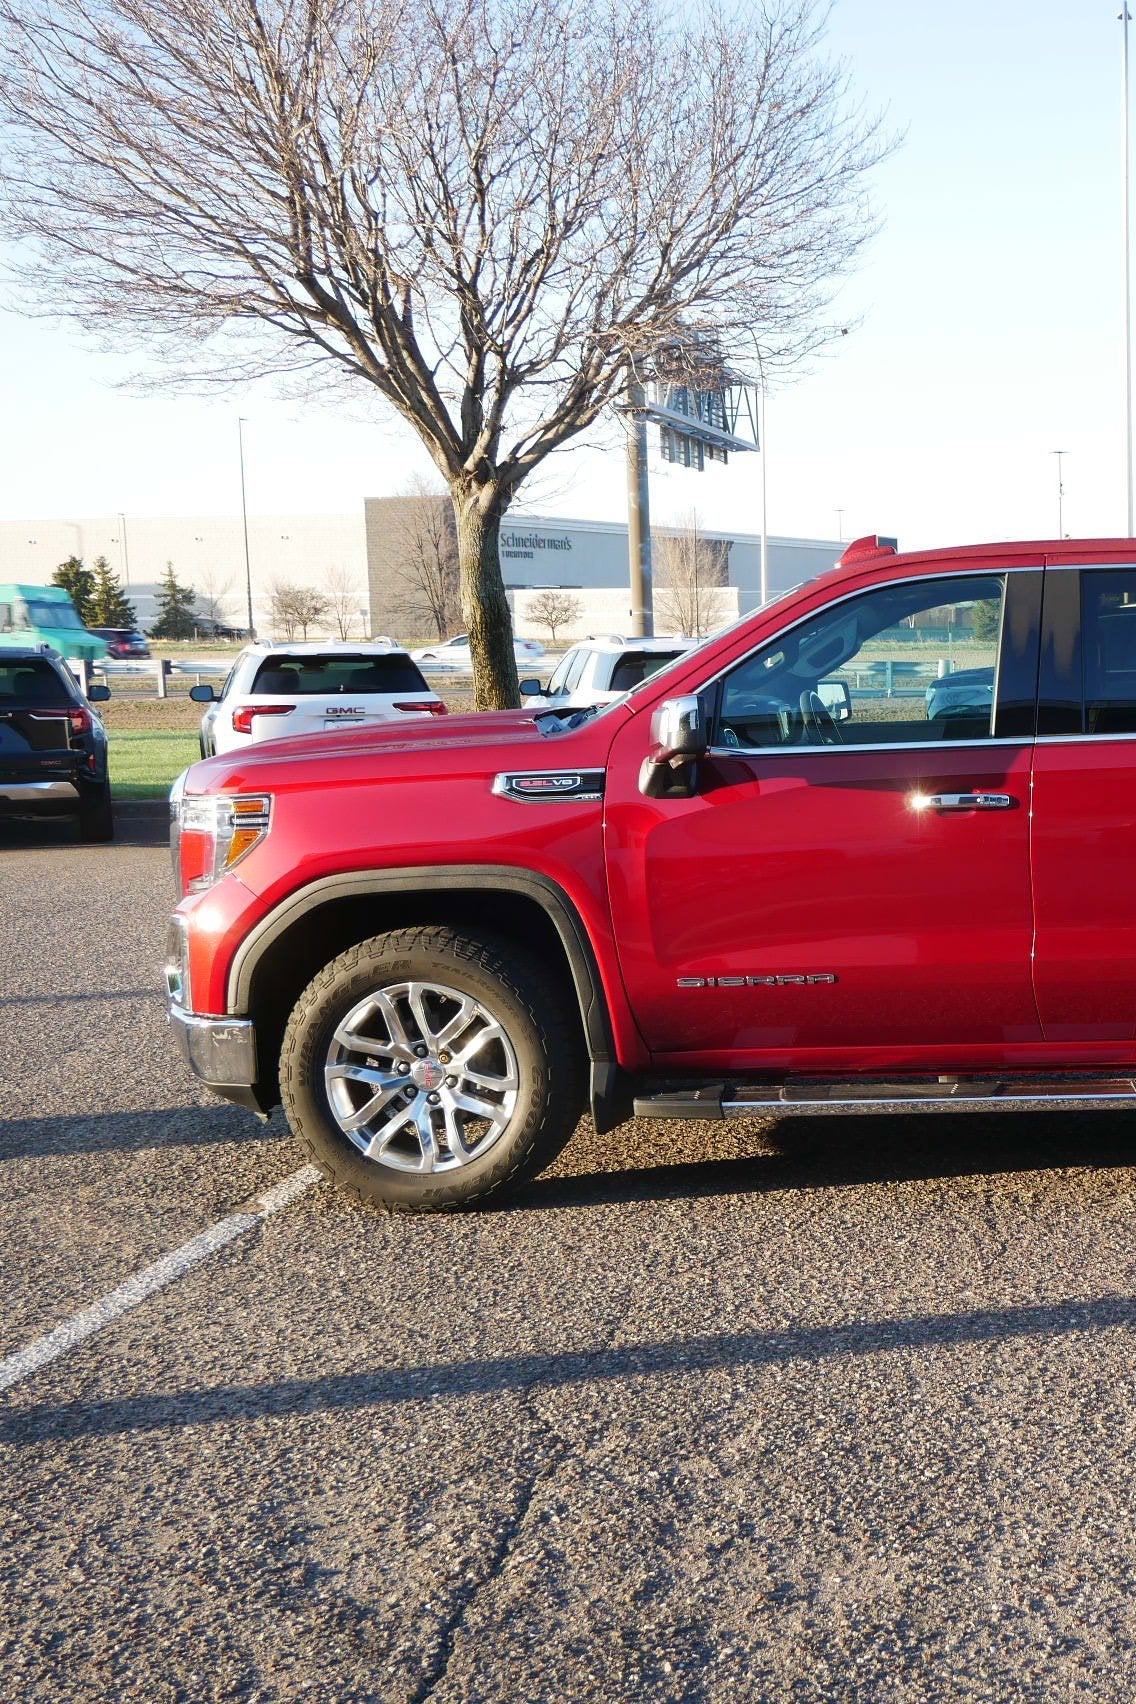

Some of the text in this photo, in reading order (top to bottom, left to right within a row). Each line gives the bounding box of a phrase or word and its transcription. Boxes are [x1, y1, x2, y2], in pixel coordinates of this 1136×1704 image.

[500, 532, 572, 551] Schneiderman's
[326, 706, 366, 714] GMC
[677, 974, 836, 988] SIERRA
